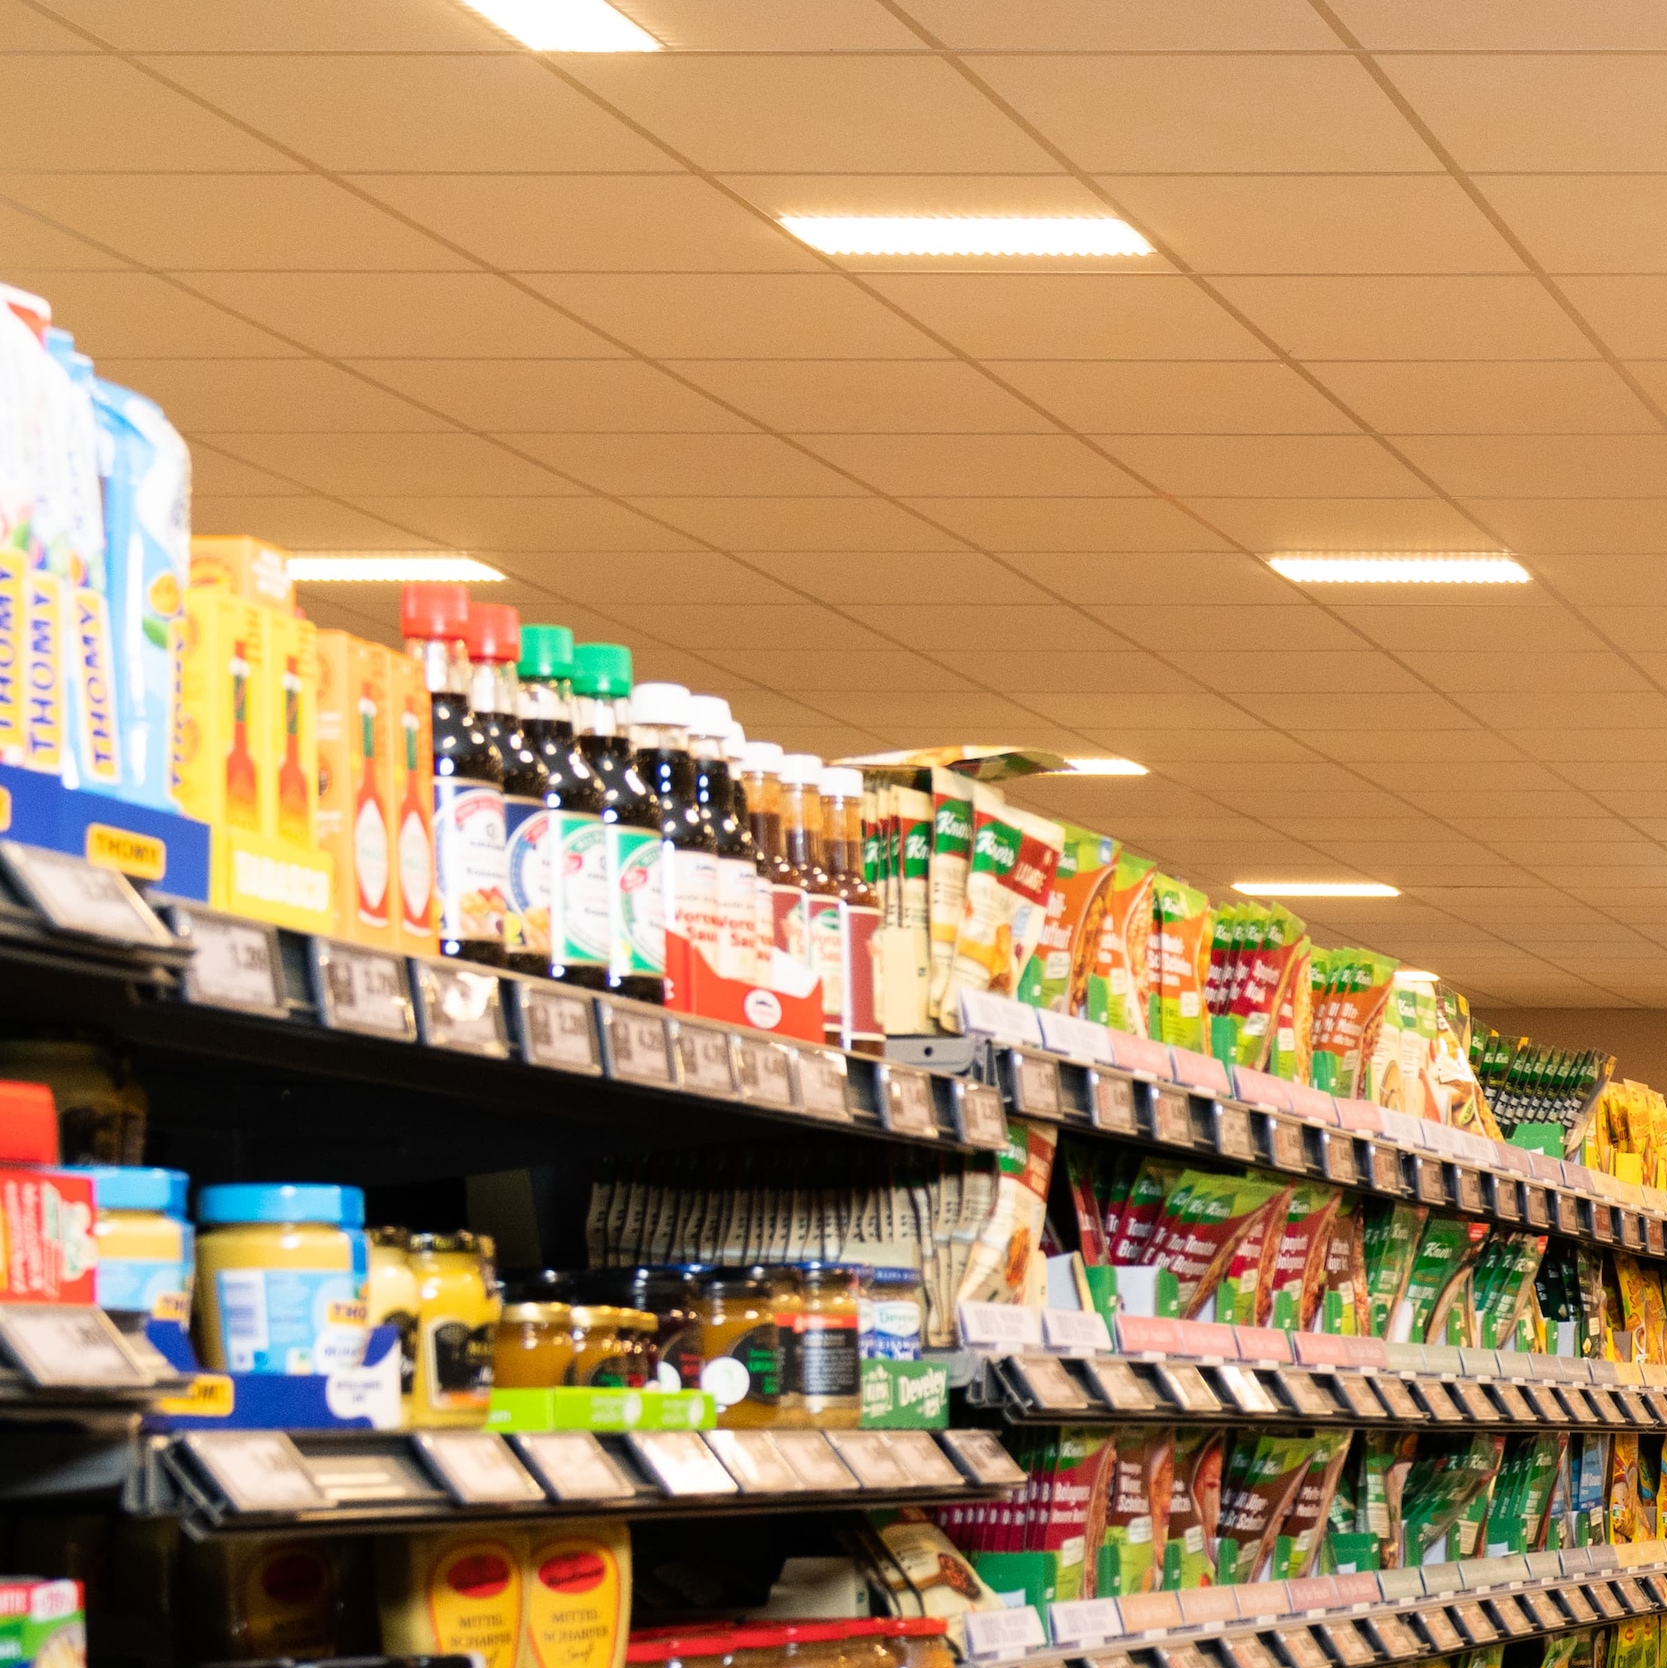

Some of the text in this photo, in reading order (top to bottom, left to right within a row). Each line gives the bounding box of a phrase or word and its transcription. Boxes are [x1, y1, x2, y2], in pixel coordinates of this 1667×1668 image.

[30, 593, 55, 753] THOMY
[80, 605, 112, 764] THOMY
[976, 830, 1016, 866] Knorr
[1423, 1242, 1452, 1258] Knorr
[900, 1370, 947, 1406] Develey
